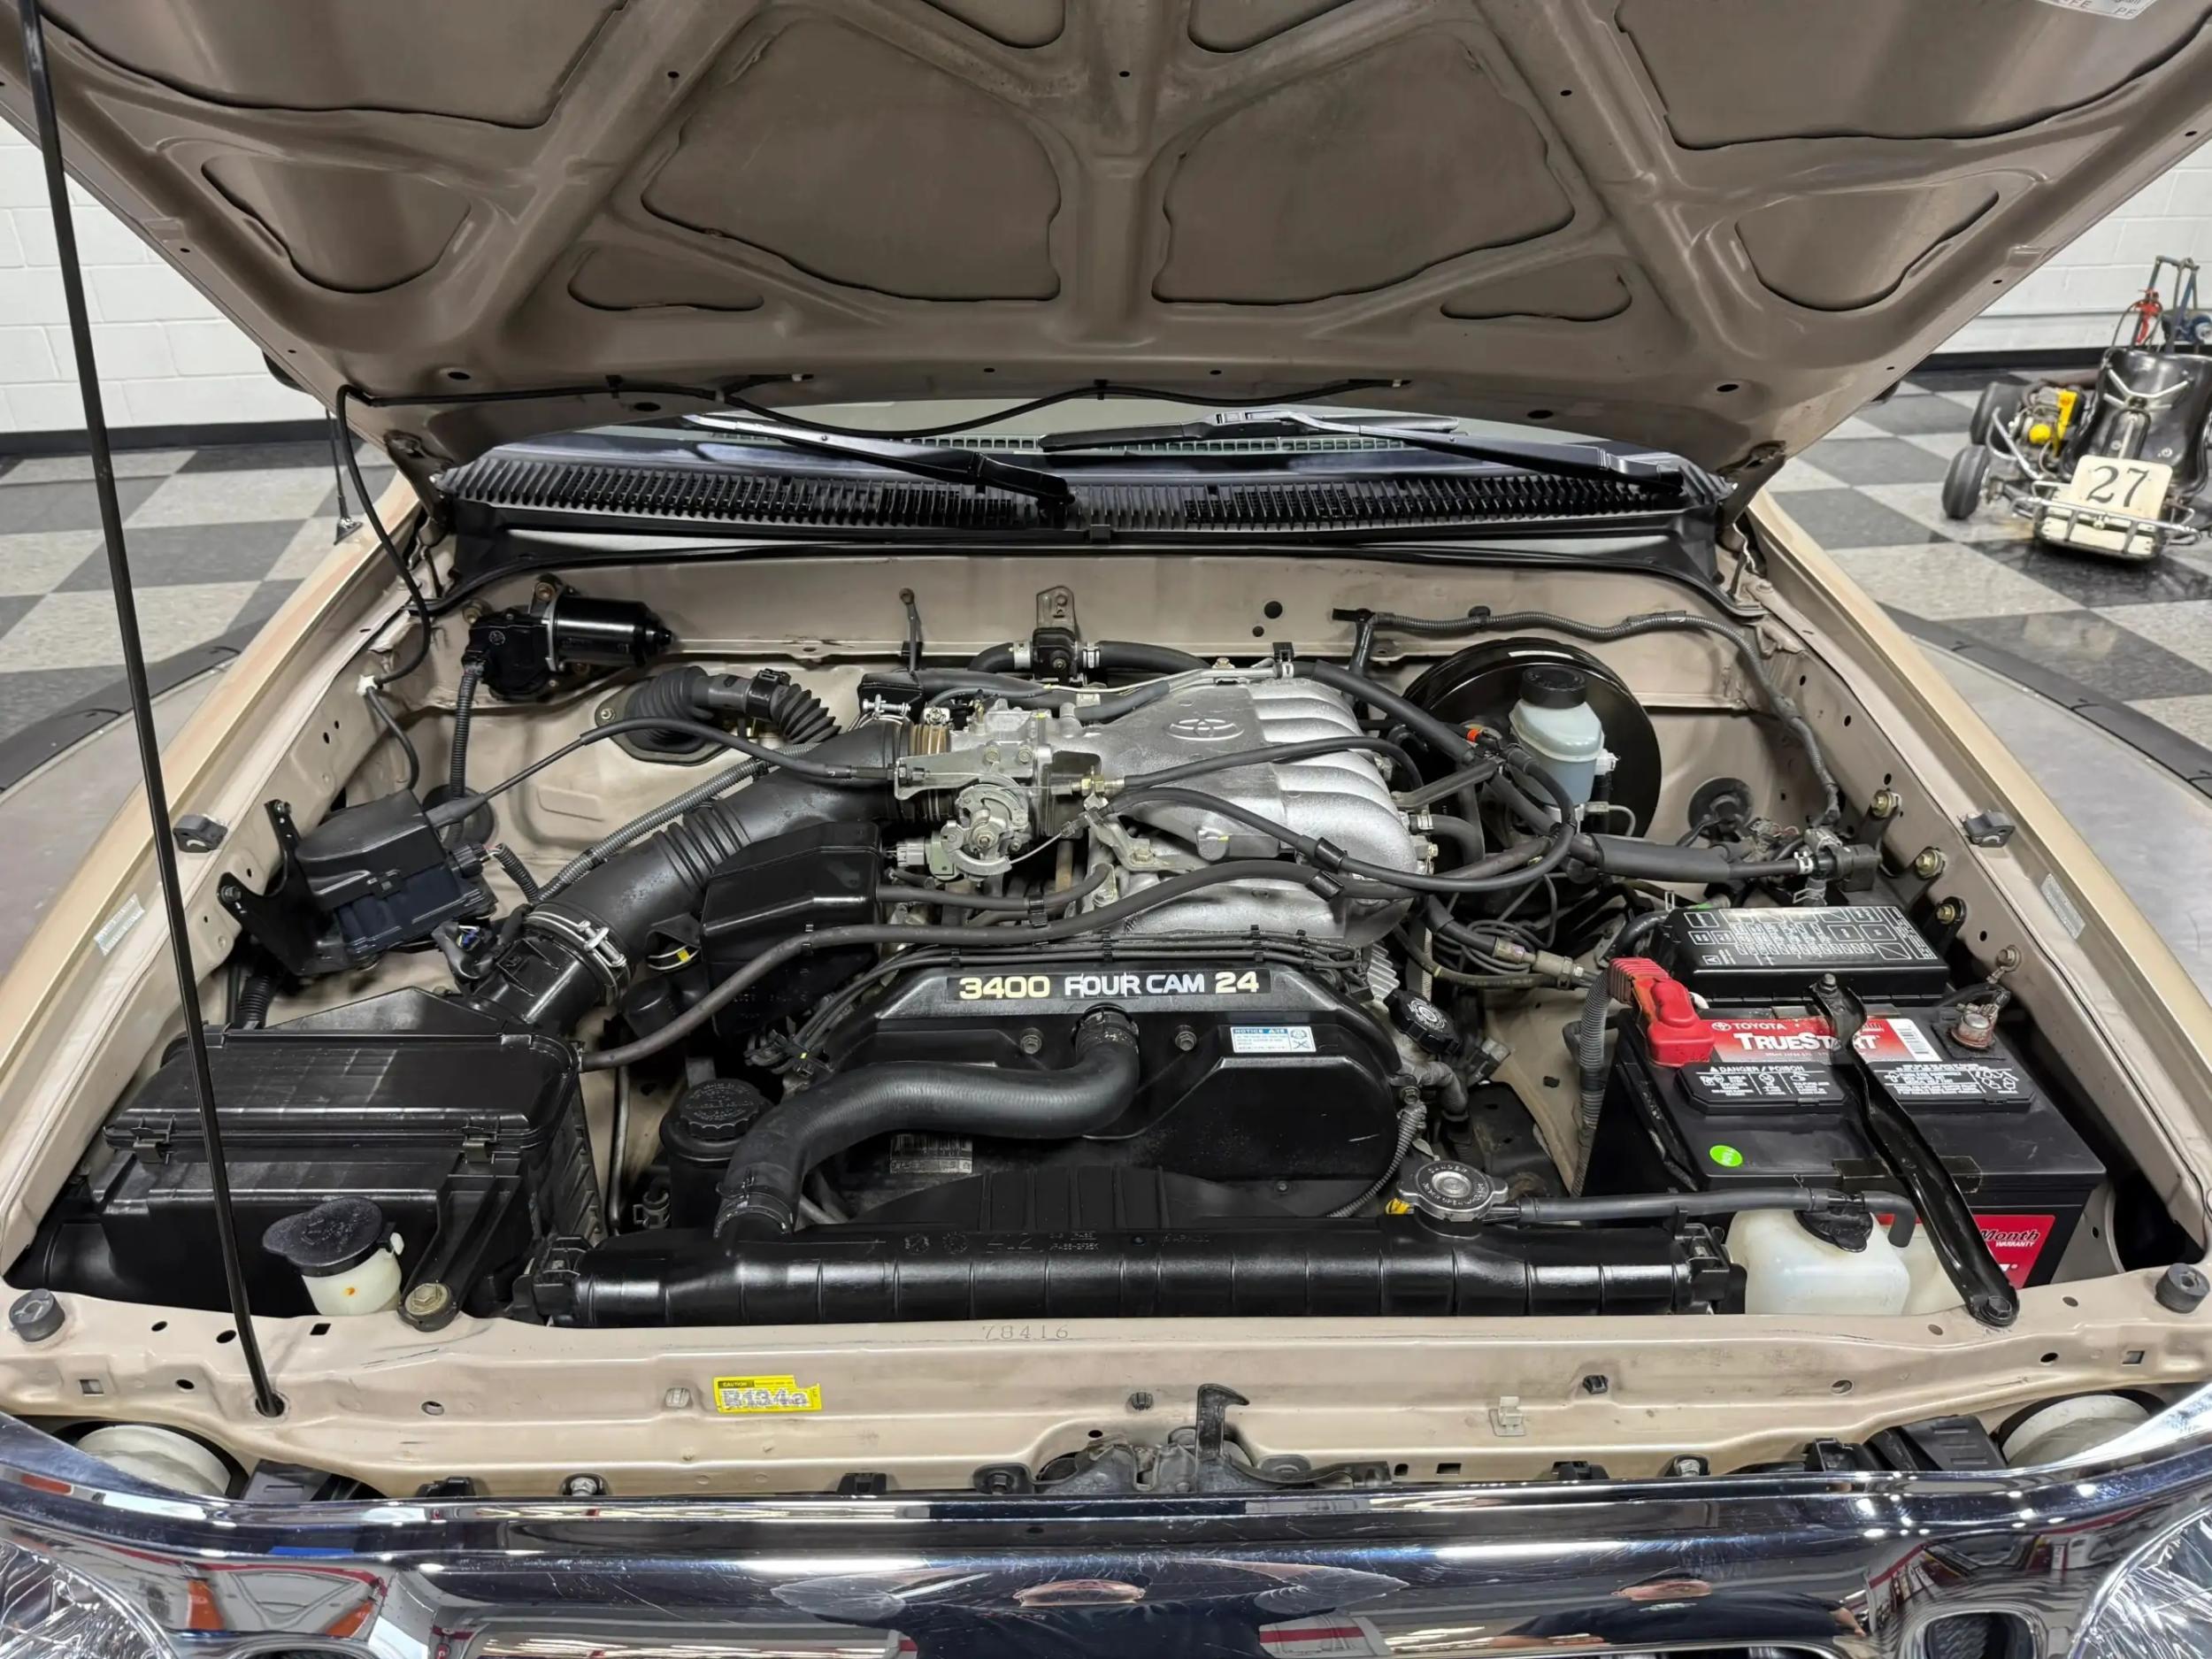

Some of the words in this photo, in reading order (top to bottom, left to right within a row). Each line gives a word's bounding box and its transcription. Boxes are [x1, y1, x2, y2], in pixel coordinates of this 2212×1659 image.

[2086, 465, 2149, 507] 27
[959, 976, 1050, 999] 3400
[1064, 974, 1141, 997] FOUR
[1146, 973, 1204, 994] CAM
[1215, 971, 1259, 995] 24
[1981, 1229, 2040, 1242] Month
[982, 1325, 1069, 1340] 78416
[721, 1387, 809, 1409] R134a
